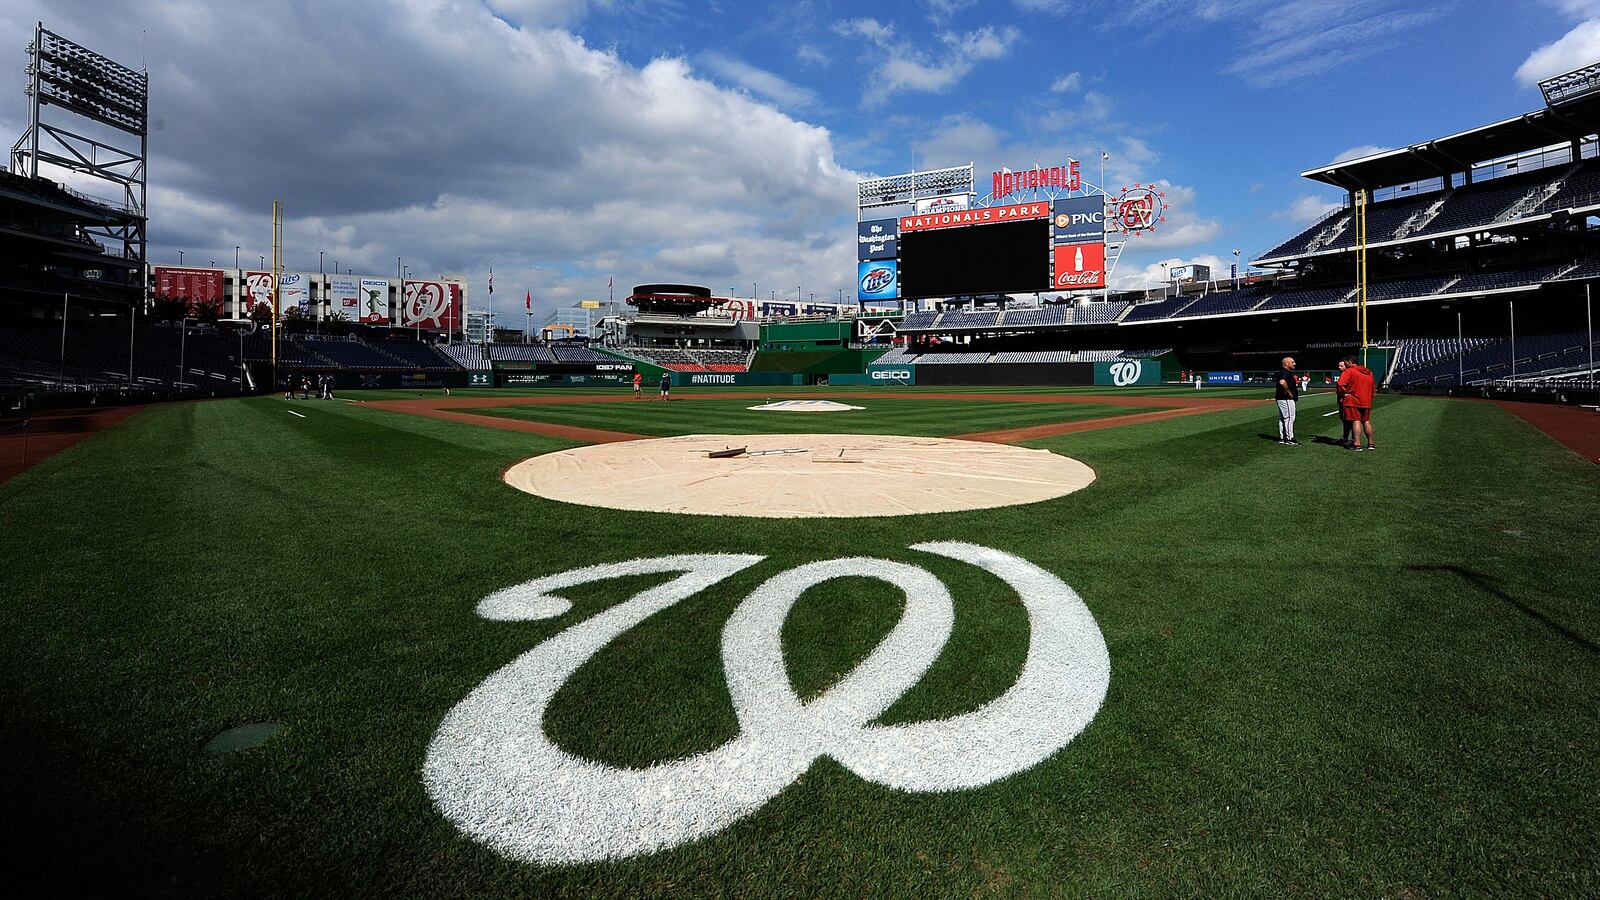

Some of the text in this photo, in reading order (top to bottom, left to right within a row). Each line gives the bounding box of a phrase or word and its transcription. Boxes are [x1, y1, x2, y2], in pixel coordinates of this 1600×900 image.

[992, 161, 1080, 199] NATIONALS
[905, 205, 1040, 228] NATIONALS PARK
[1071, 211, 1103, 225] PNC
[870, 225, 883, 233] The
[859, 234, 895, 243] Washington
[869, 244, 884, 253] Post
[1058, 269, 1102, 286] Coca-Cola
[1305, 340, 1362, 349] nationals.com
[872, 371, 910, 379] GEICO
[1109, 359, 1141, 386] W
[691, 374, 736, 384] #NATITUDE
[422, 541, 1111, 866] W
